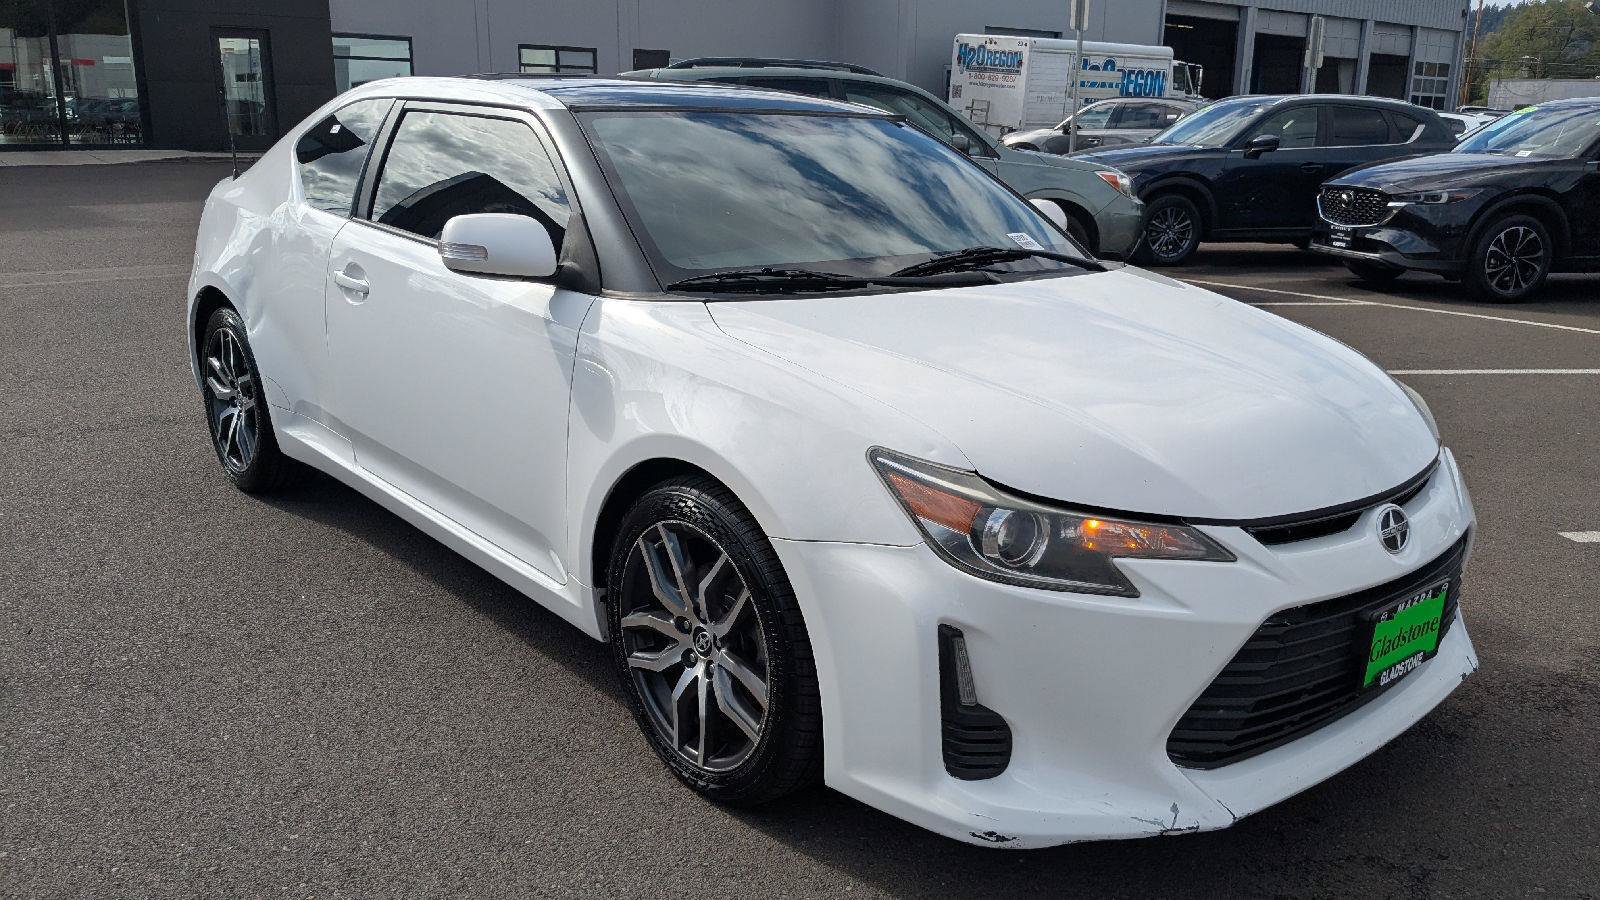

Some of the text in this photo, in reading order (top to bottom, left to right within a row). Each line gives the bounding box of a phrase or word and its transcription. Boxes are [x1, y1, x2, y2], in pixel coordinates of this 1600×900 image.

[1397, 589, 1433, 613] MAZDA
[1370, 616, 1439, 663] Gladstone
[1380, 651, 1424, 687] GLADSTONE
